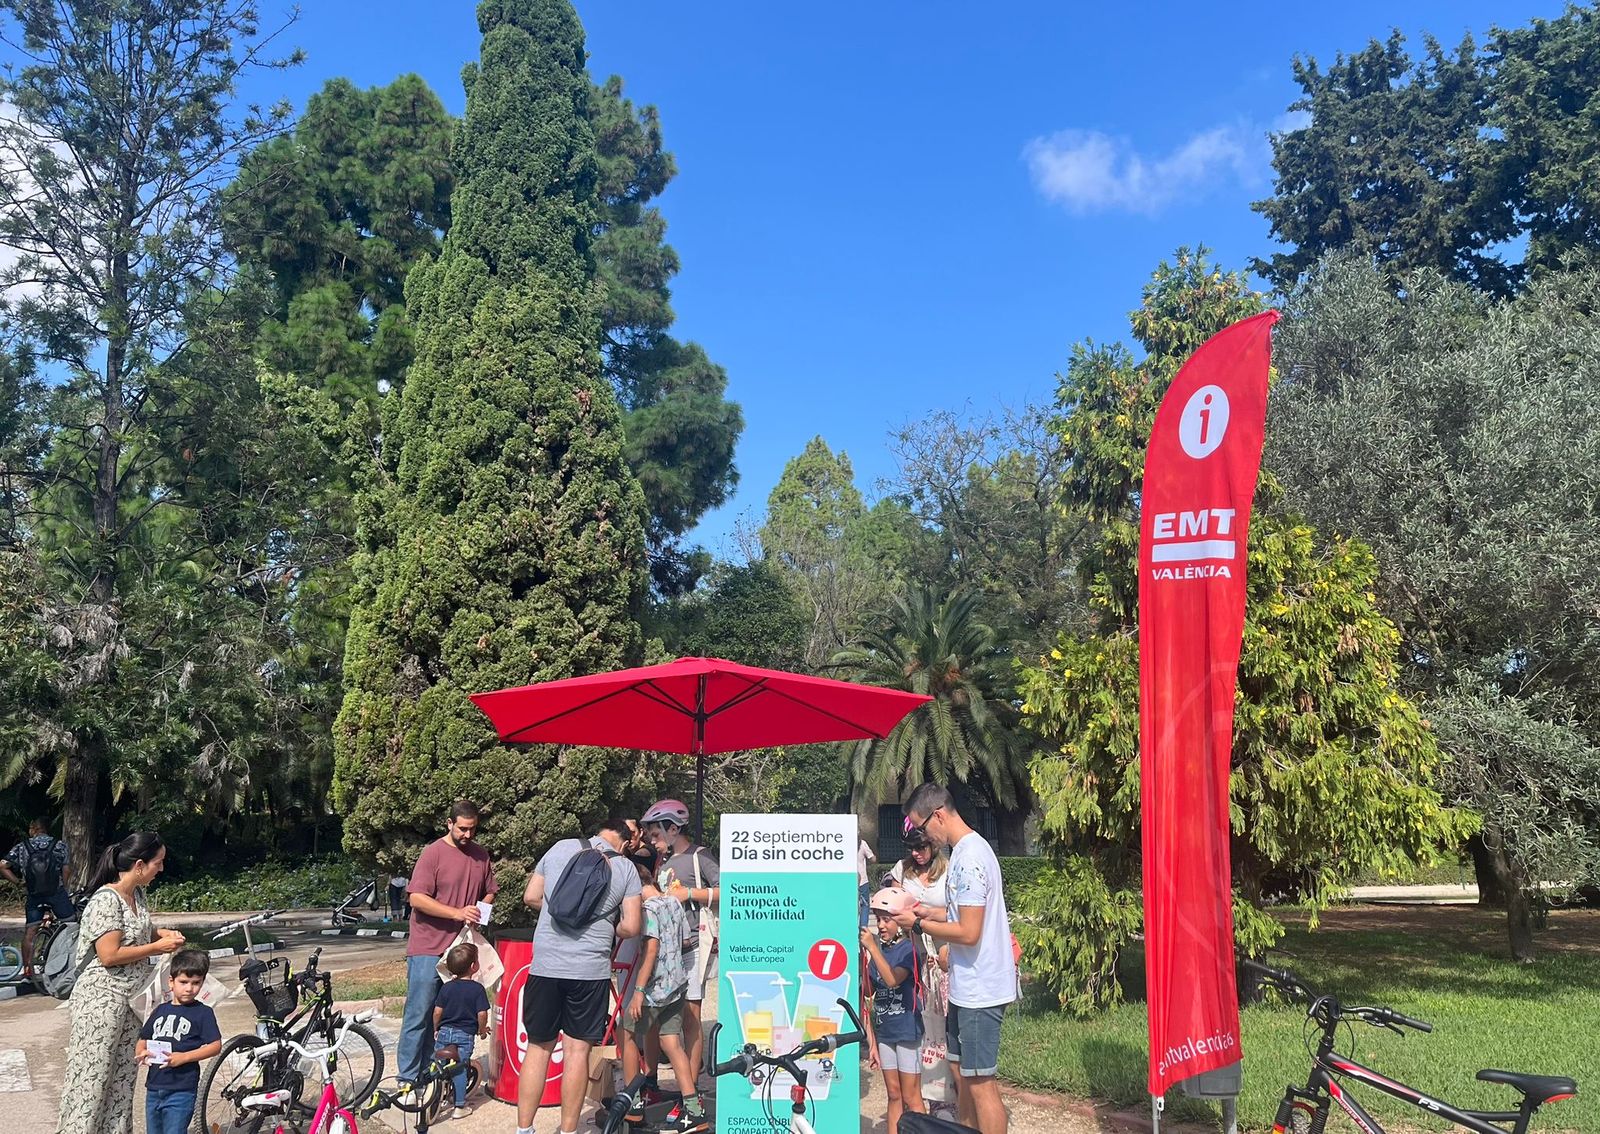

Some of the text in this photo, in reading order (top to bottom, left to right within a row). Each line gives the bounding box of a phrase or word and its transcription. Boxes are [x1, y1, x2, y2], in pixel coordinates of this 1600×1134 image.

[1153, 508, 1236, 540] EMT
[1152, 563, 1232, 581] VALÈNCIA
[731, 830, 843, 846] 22 Septiembre
[731, 845, 844, 860] Día sin coche
[730, 883, 778, 894] Semana
[730, 896, 797, 909] Europea de
[730, 909, 805, 920] la Movilidad
[729, 945, 795, 954] València, Capital
[751, 955, 785, 964] Europea
[818, 944, 836, 975] 7
[152, 1014, 192, 1041] GAP
[1417, 1097, 1440, 1111] FS
[727, 1117, 767, 1126] ESPACIO
